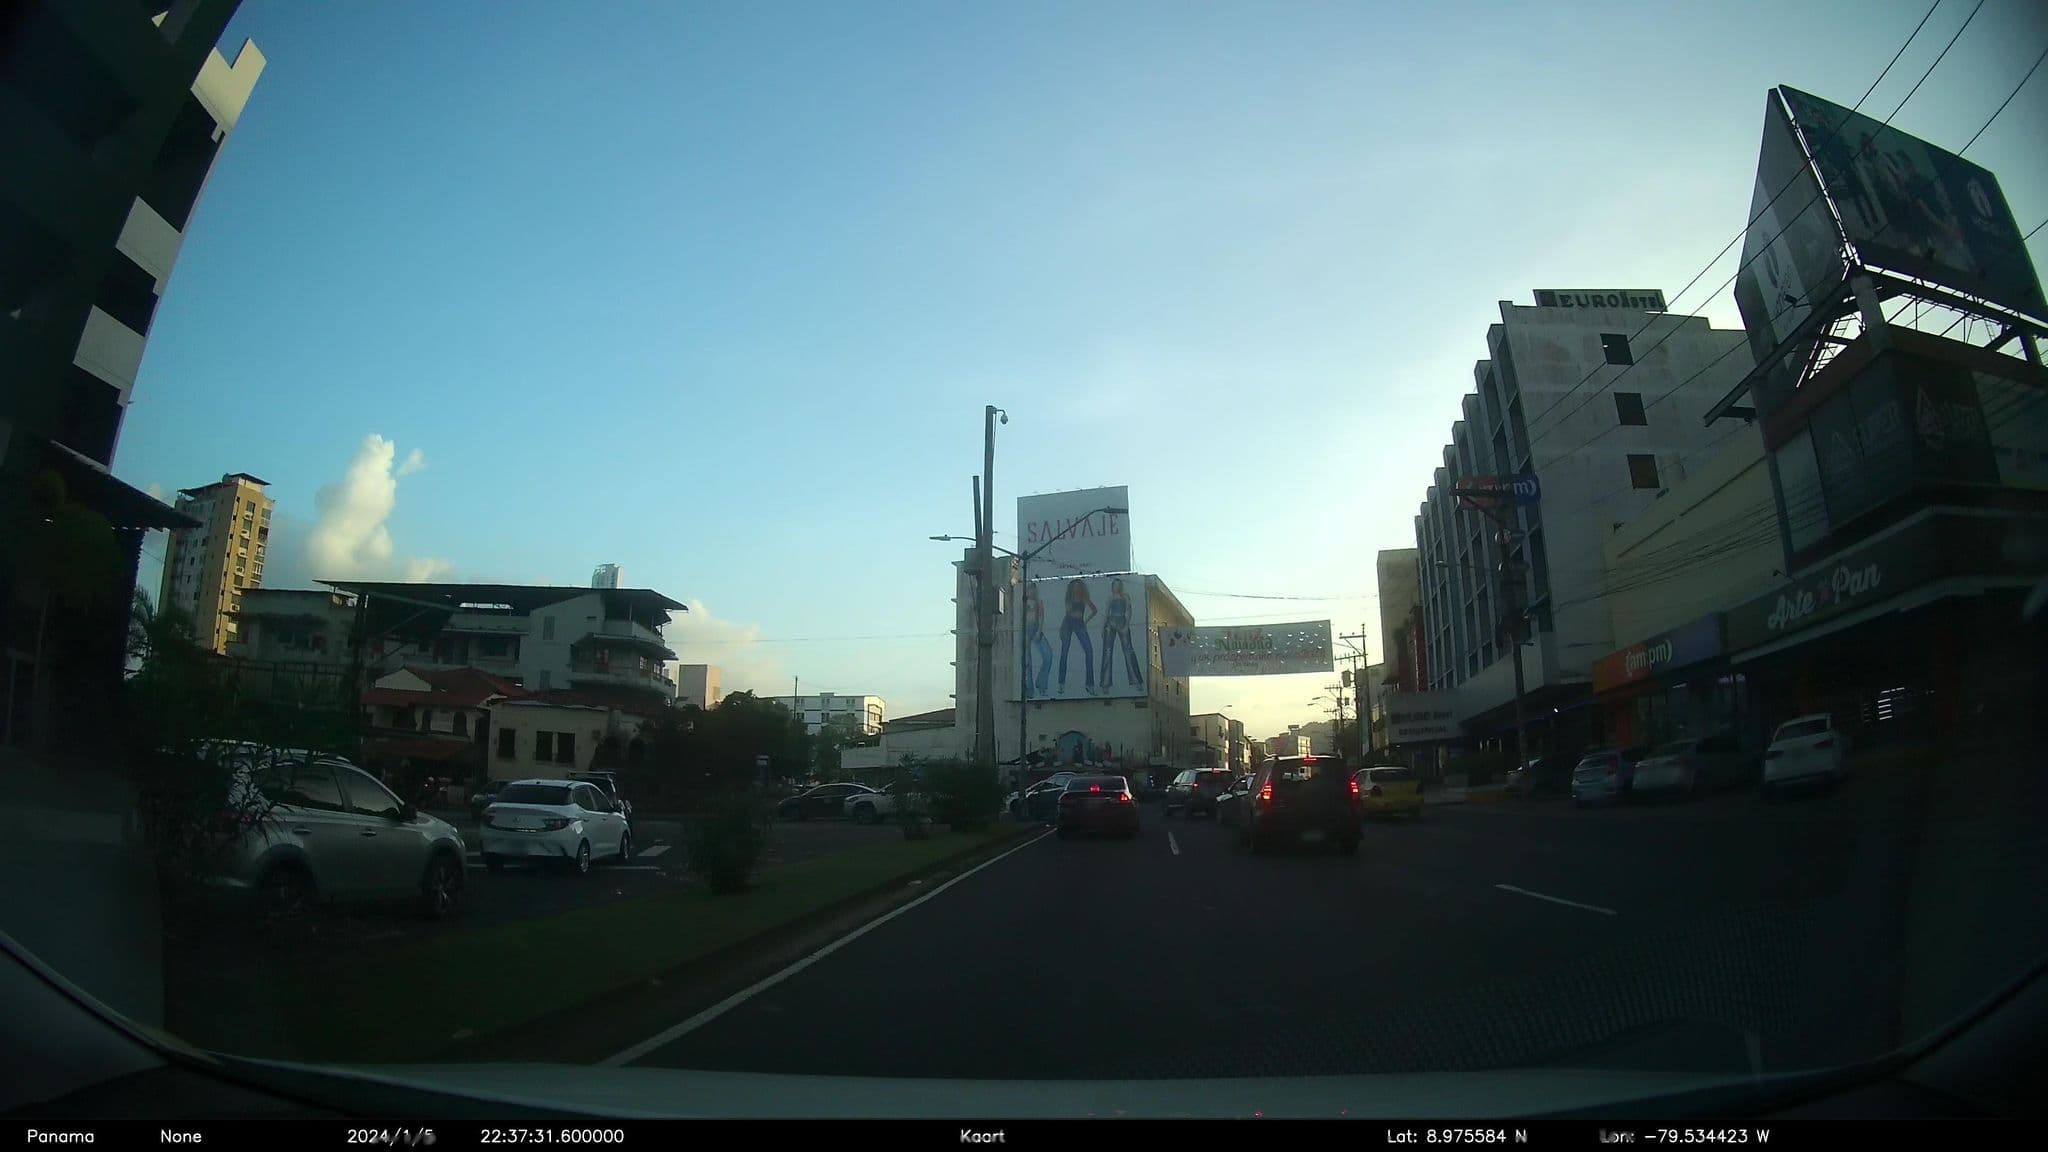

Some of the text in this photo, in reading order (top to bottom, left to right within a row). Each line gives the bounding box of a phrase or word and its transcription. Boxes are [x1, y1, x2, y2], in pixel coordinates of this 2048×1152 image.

[1027, 512, 1120, 544] SALVAJE
[1767, 563, 1881, 630] Arte Pan
